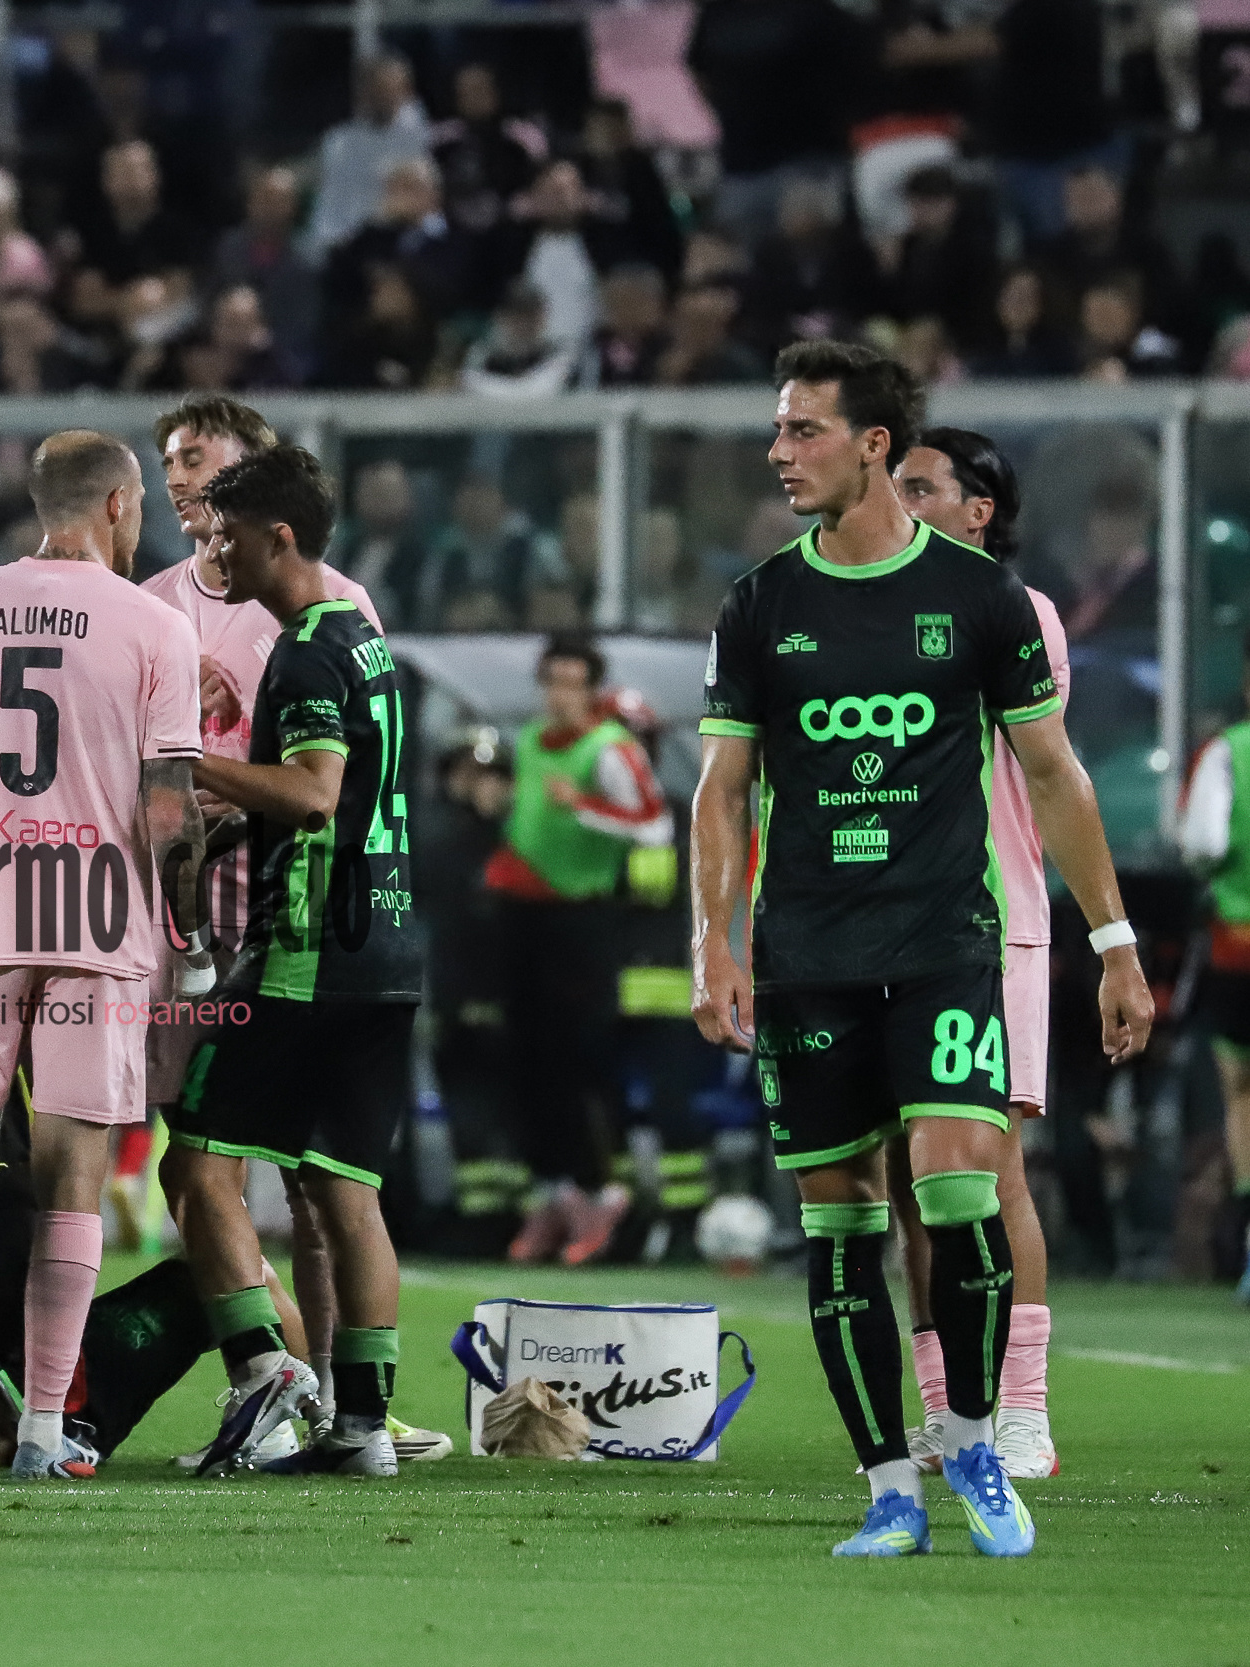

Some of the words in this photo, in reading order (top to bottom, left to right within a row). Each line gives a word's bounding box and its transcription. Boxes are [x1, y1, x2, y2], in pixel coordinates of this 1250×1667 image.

[800, 692, 935, 747] coop
[817, 784, 919, 806] Bencivenni
[931, 1008, 1006, 1096] 84
